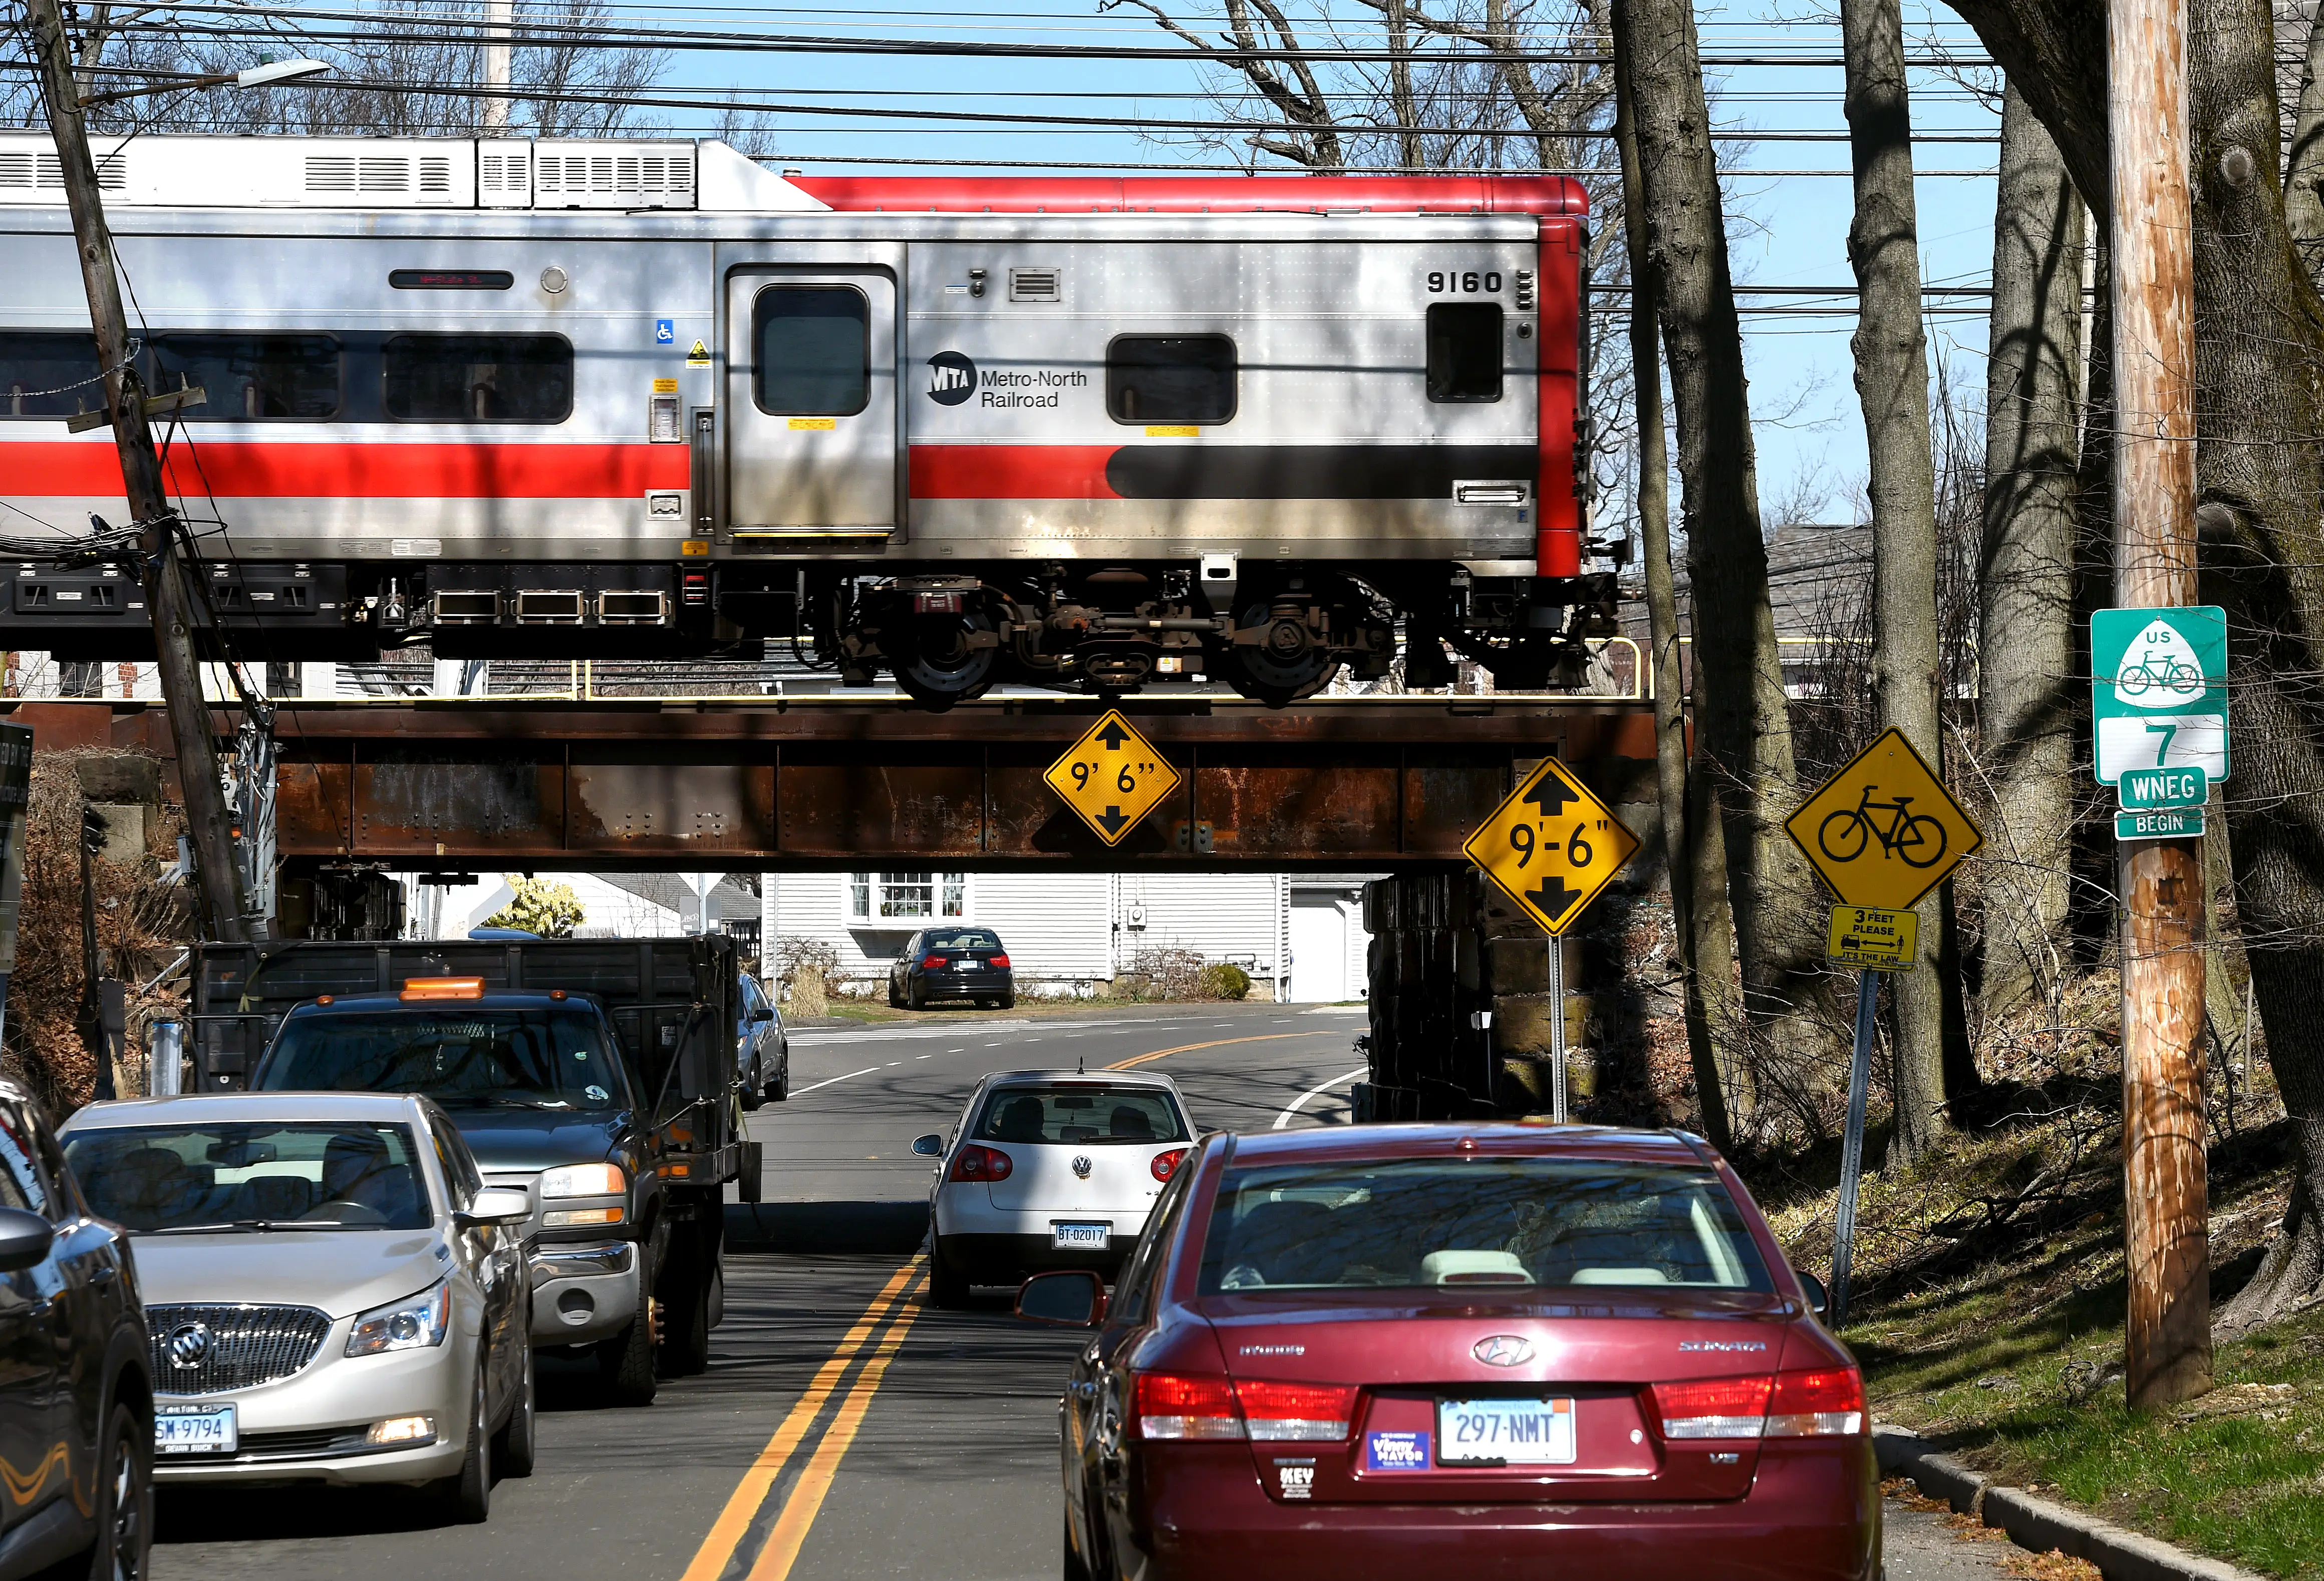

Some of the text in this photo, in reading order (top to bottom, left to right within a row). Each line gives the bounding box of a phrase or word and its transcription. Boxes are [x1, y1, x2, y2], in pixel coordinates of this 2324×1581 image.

[1428, 272, 1502, 292] 9160
[927, 365, 969, 393] MTA
[981, 370, 1086, 387] Metro-North
[981, 392, 1058, 408] Railroad
[2146, 631, 2171, 643] US
[2146, 725, 2176, 766] 7
[2132, 775, 2195, 801] WNEG
[2136, 815, 2183, 832] BEGIN
[1855, 910, 1895, 923] 3 FEET
[1853, 925, 1895, 935] PLEASE
[1679, 1341, 1766, 1352] SONATA
[1373, 1438, 1414, 1452] Vinny
[1377, 1450, 1423, 1461] MAYOR
[1280, 1467, 1314, 1484] KEY
